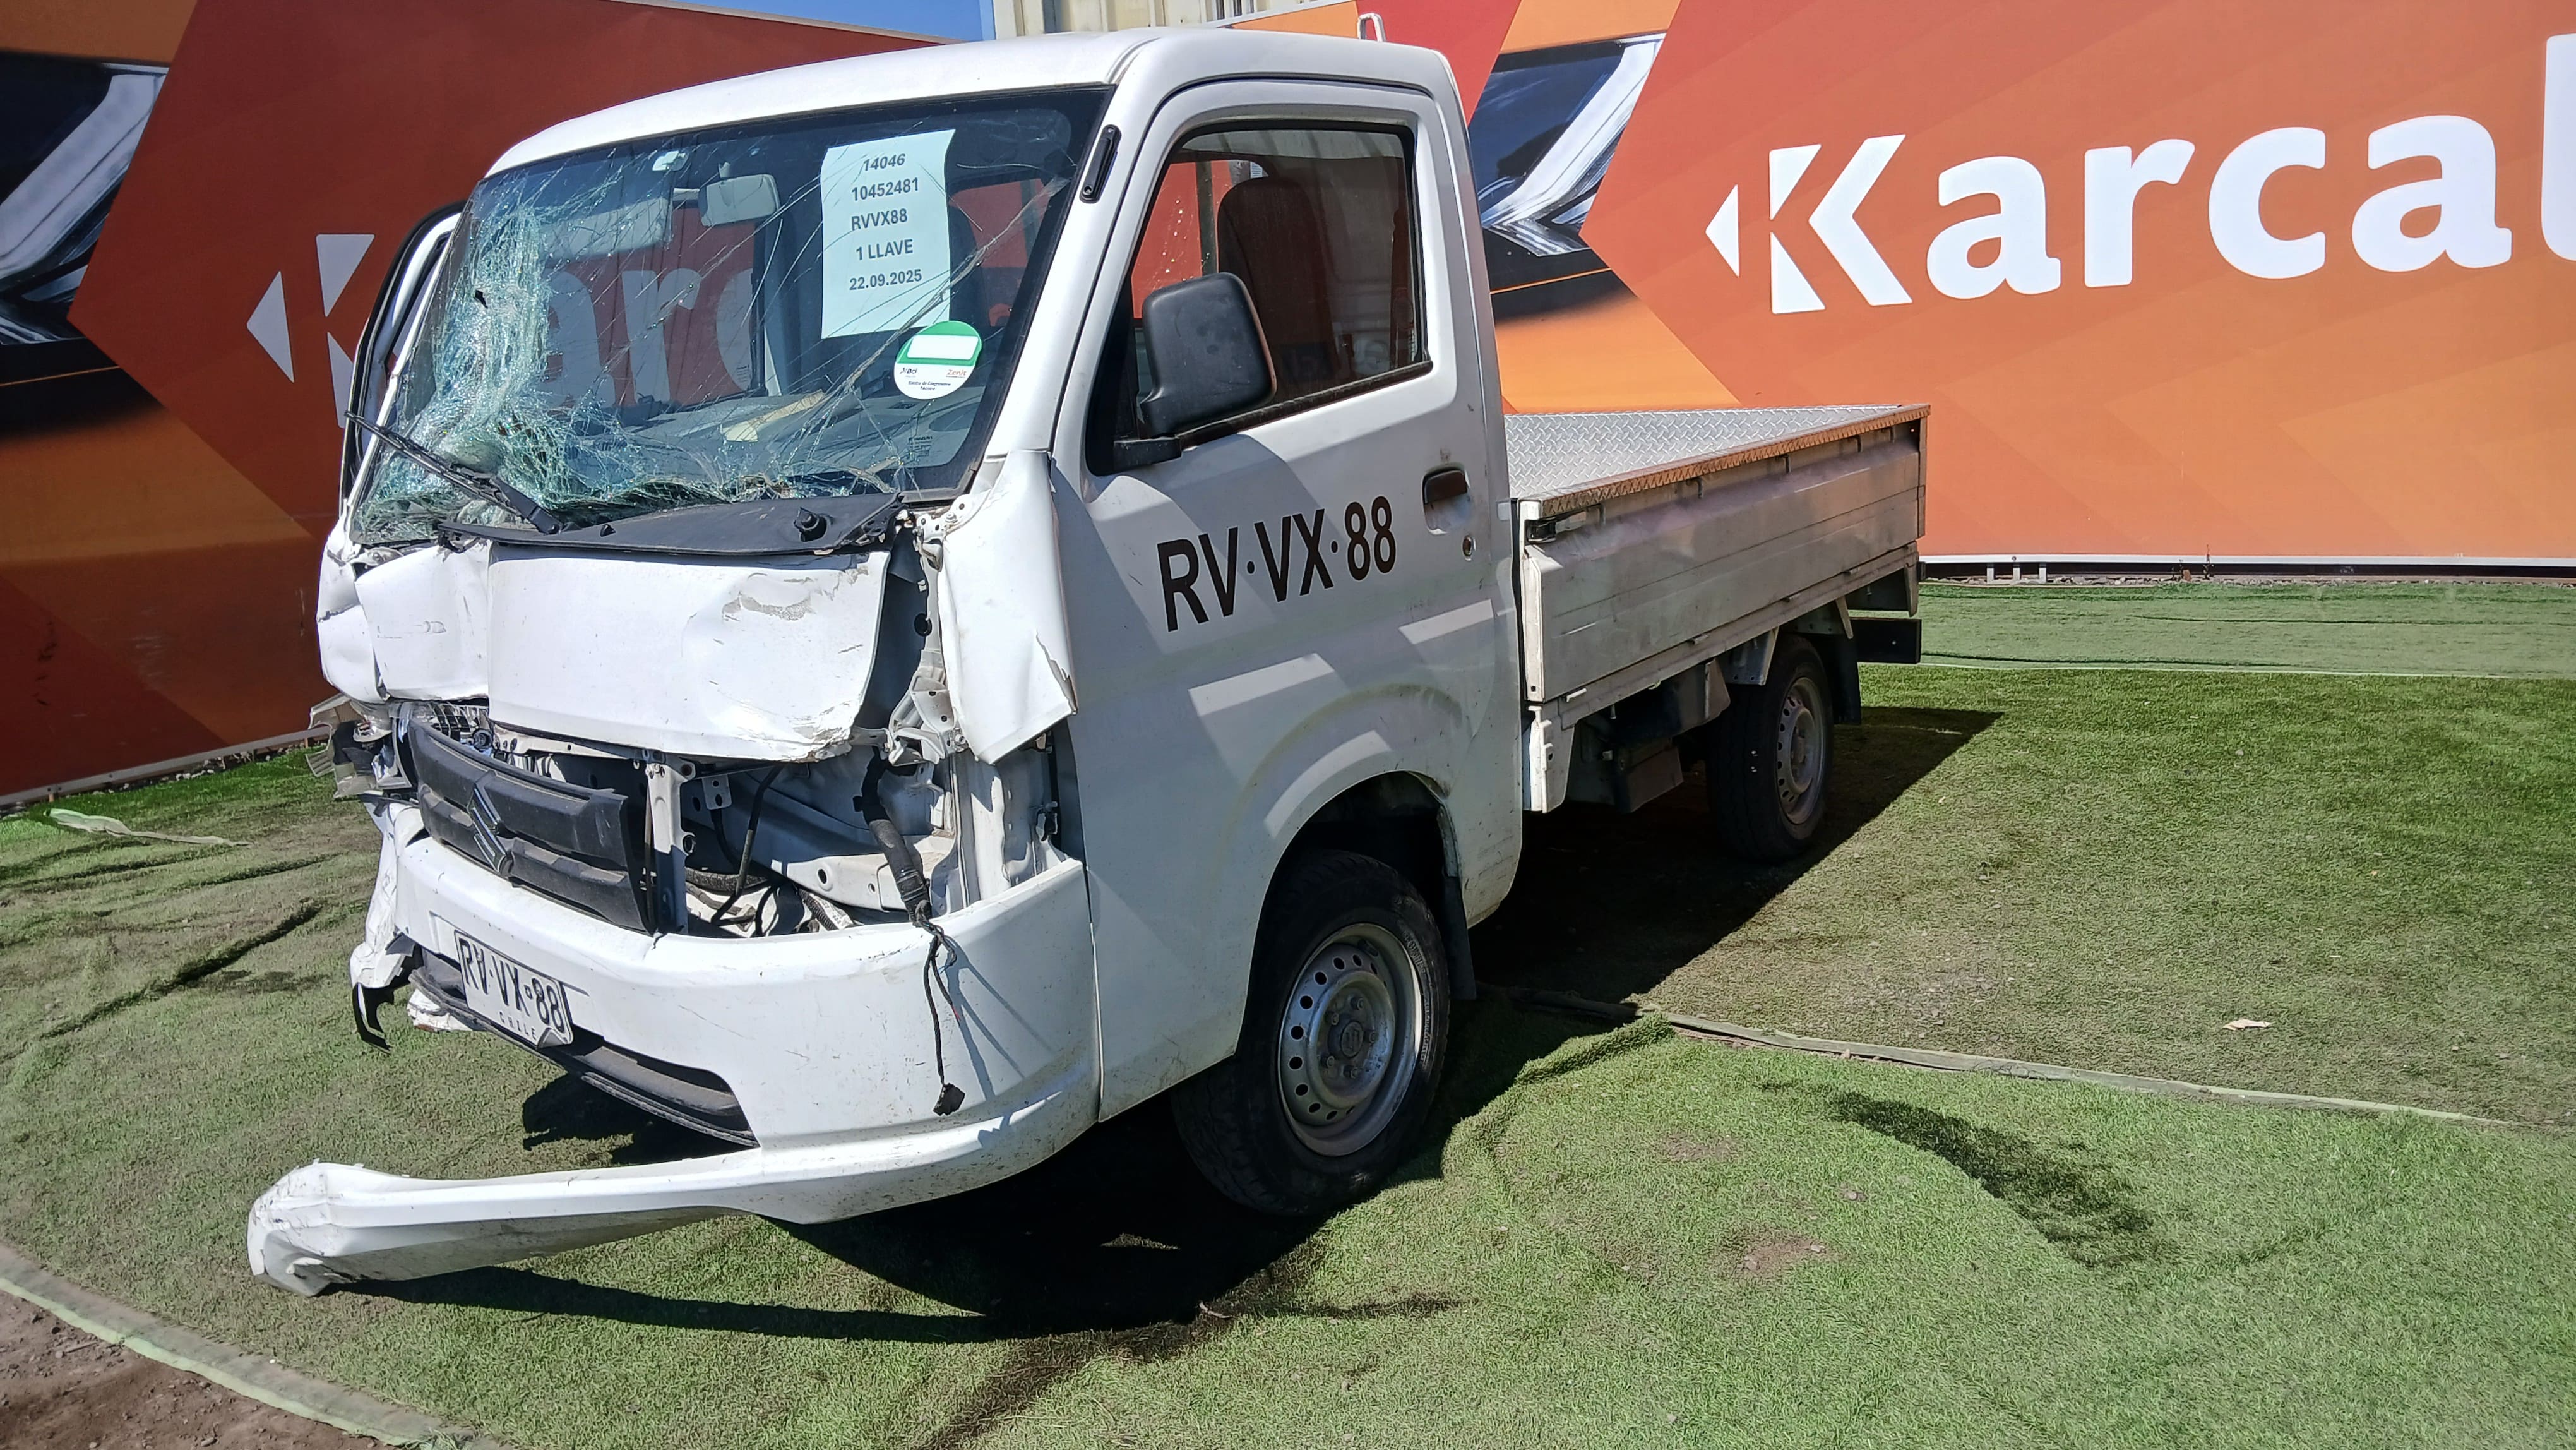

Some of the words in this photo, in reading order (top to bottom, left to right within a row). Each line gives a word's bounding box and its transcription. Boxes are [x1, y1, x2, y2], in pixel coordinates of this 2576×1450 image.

[863, 153, 906, 172] 14046
[1768, 33, 2576, 315] Karcal
[851, 177, 920, 201] 10452481
[850, 208, 909, 231] RVVX88
[856, 247, 864, 261] 1
[868, 239, 914, 259] LLAVE
[849, 269, 922, 291] 22.09.2025
[498, 1011, 537, 1040] CHILE
